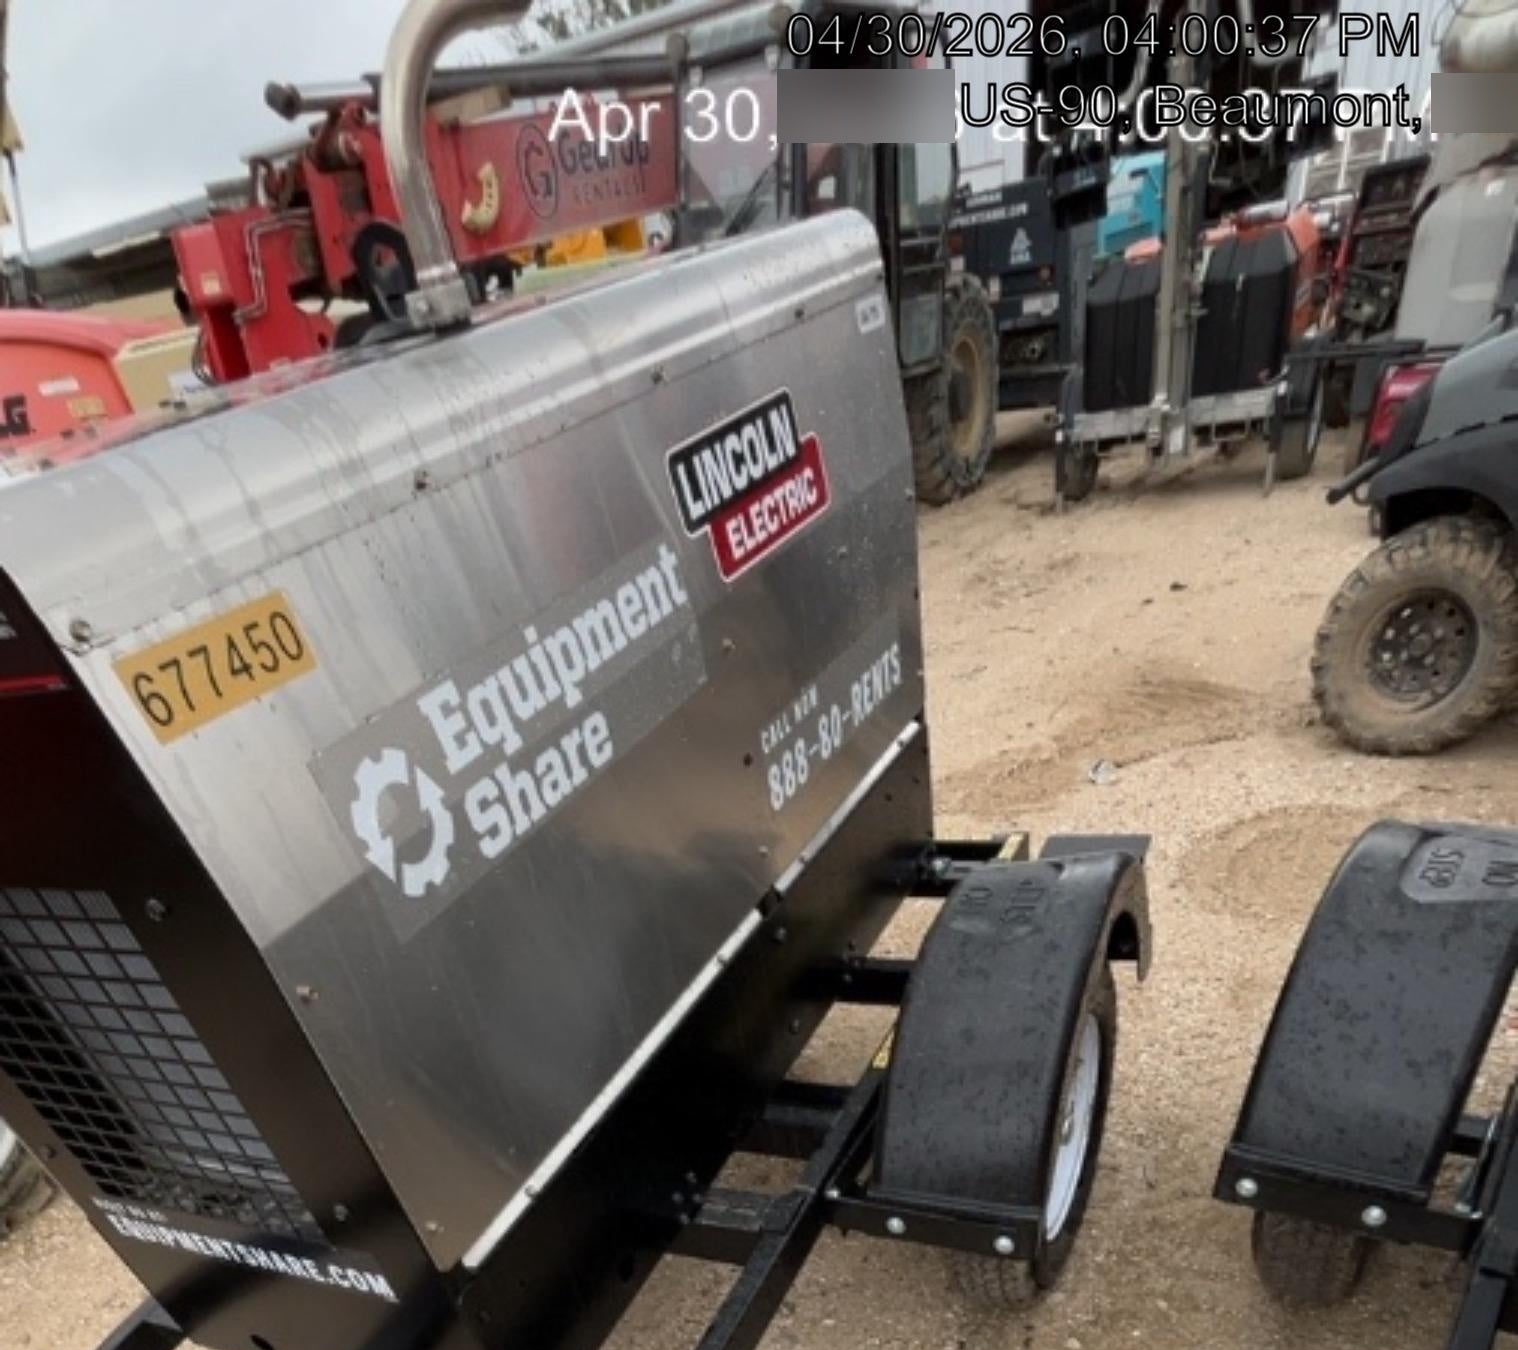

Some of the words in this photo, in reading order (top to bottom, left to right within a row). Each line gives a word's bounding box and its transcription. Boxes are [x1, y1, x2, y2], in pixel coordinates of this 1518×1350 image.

[677, 403, 797, 520] LINCOLN
[725, 467, 818, 560] ELECTRIC
[132, 611, 305, 727] 677450
[416, 543, 689, 775] Equipment
[760, 712, 792, 755] CALL
[767, 641, 902, 812] 888-80-RENTS
[464, 711, 613, 860] Share
[105, 1213, 400, 1303] EQUIPMENTSHARE.COM
